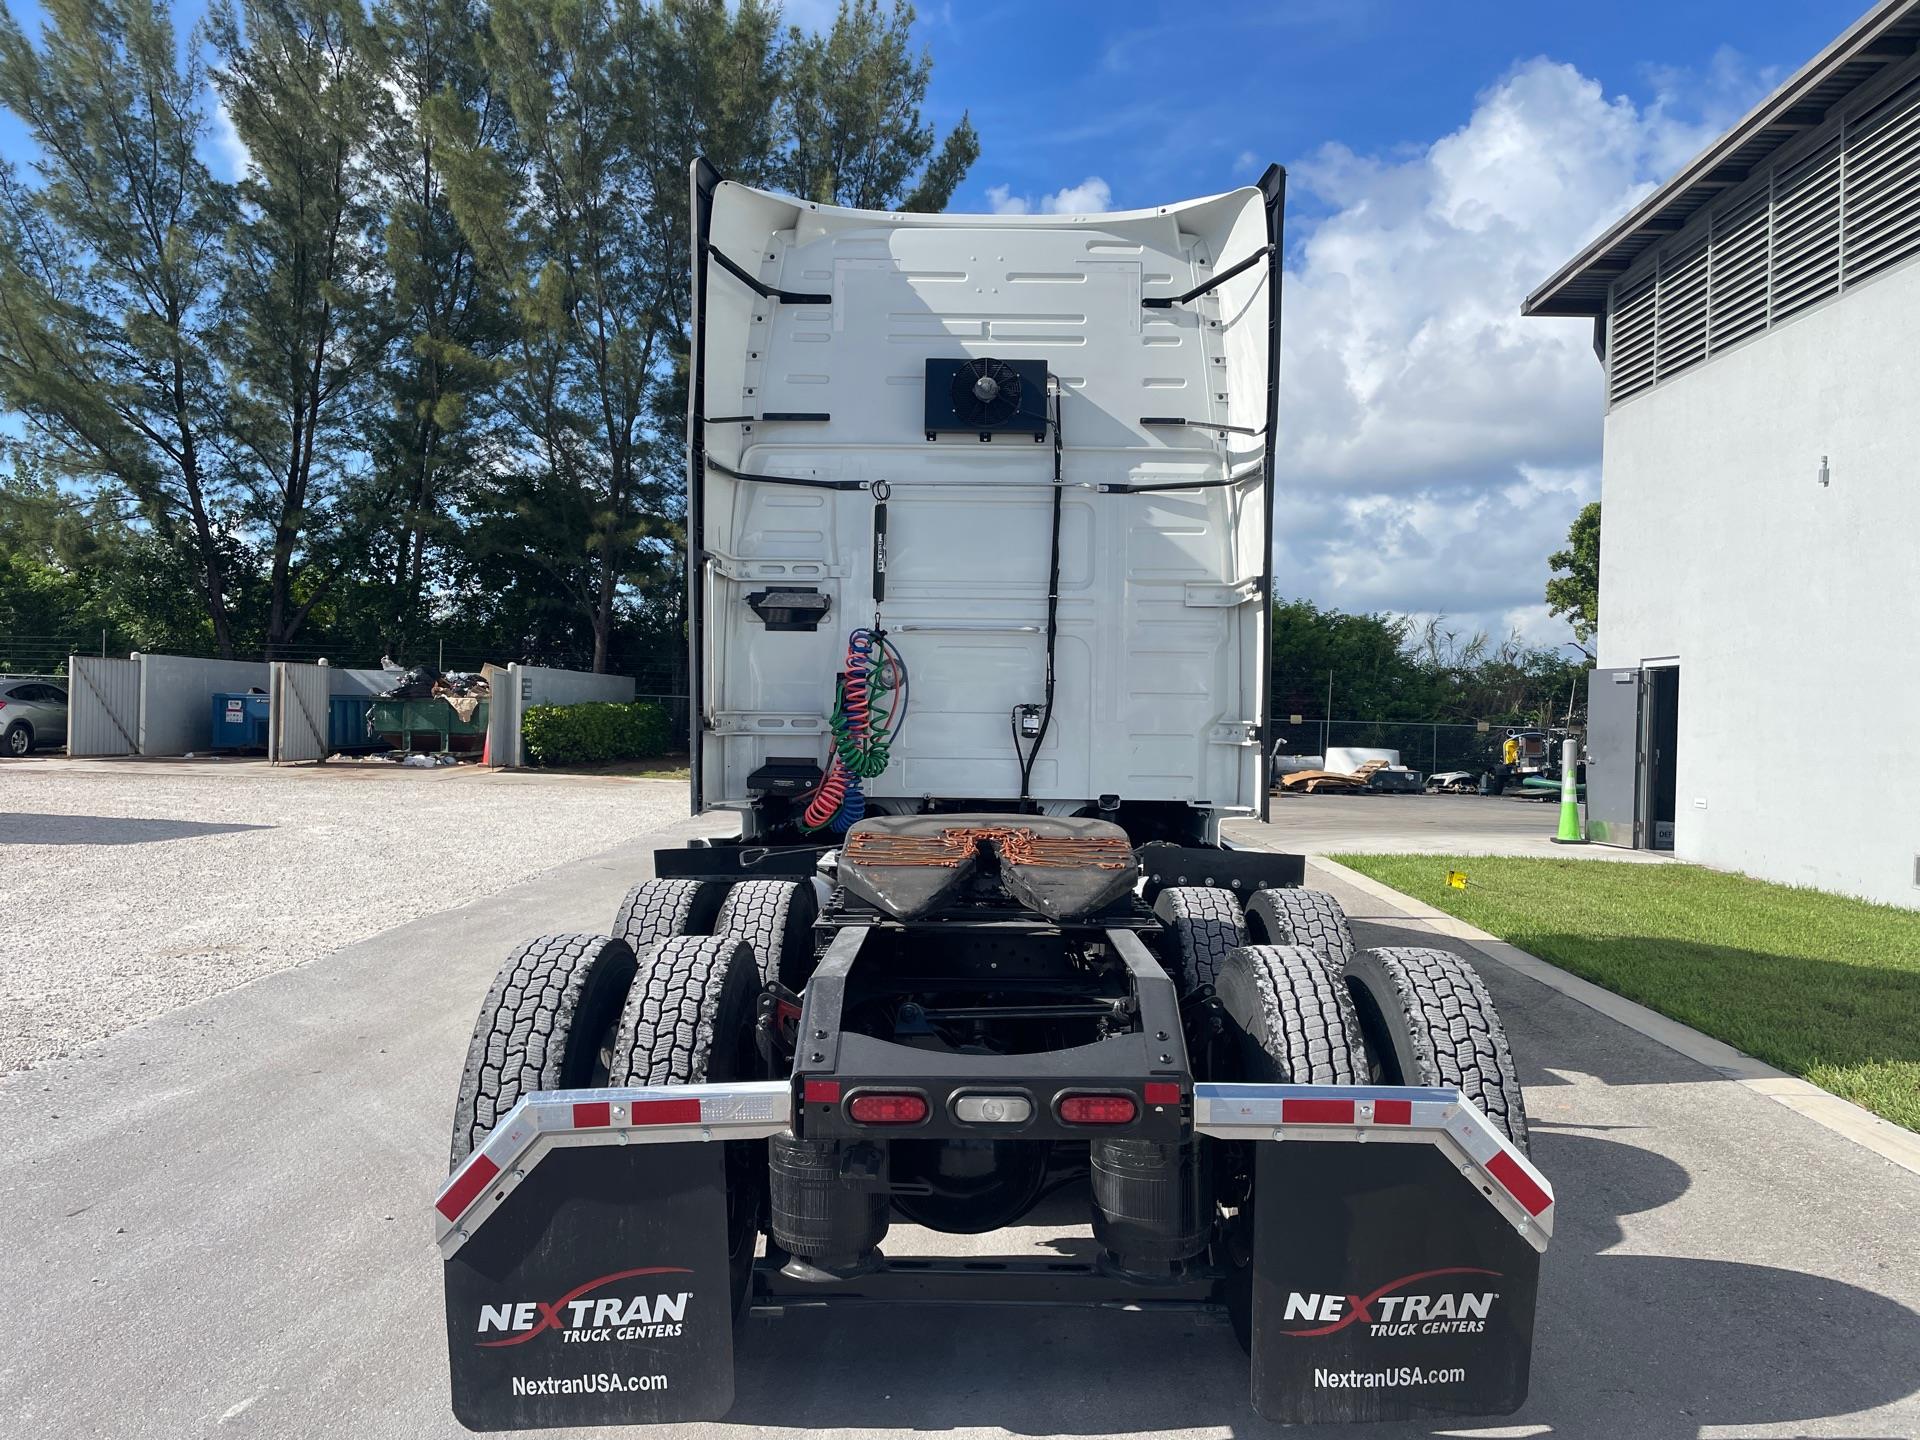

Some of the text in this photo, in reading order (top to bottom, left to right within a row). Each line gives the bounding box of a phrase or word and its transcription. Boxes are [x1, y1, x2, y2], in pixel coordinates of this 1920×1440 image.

[477, 1292, 688, 1332] NEXTRAN
[1283, 1292, 1493, 1322] NEXTRAN
[562, 1323, 683, 1344] TRUCK CENTERS
[1370, 1320, 1485, 1337] TRUCK CENTERS
[512, 1373, 668, 1396] NextranUSA.com
[1314, 1366, 1465, 1389] NextranUSA.com
